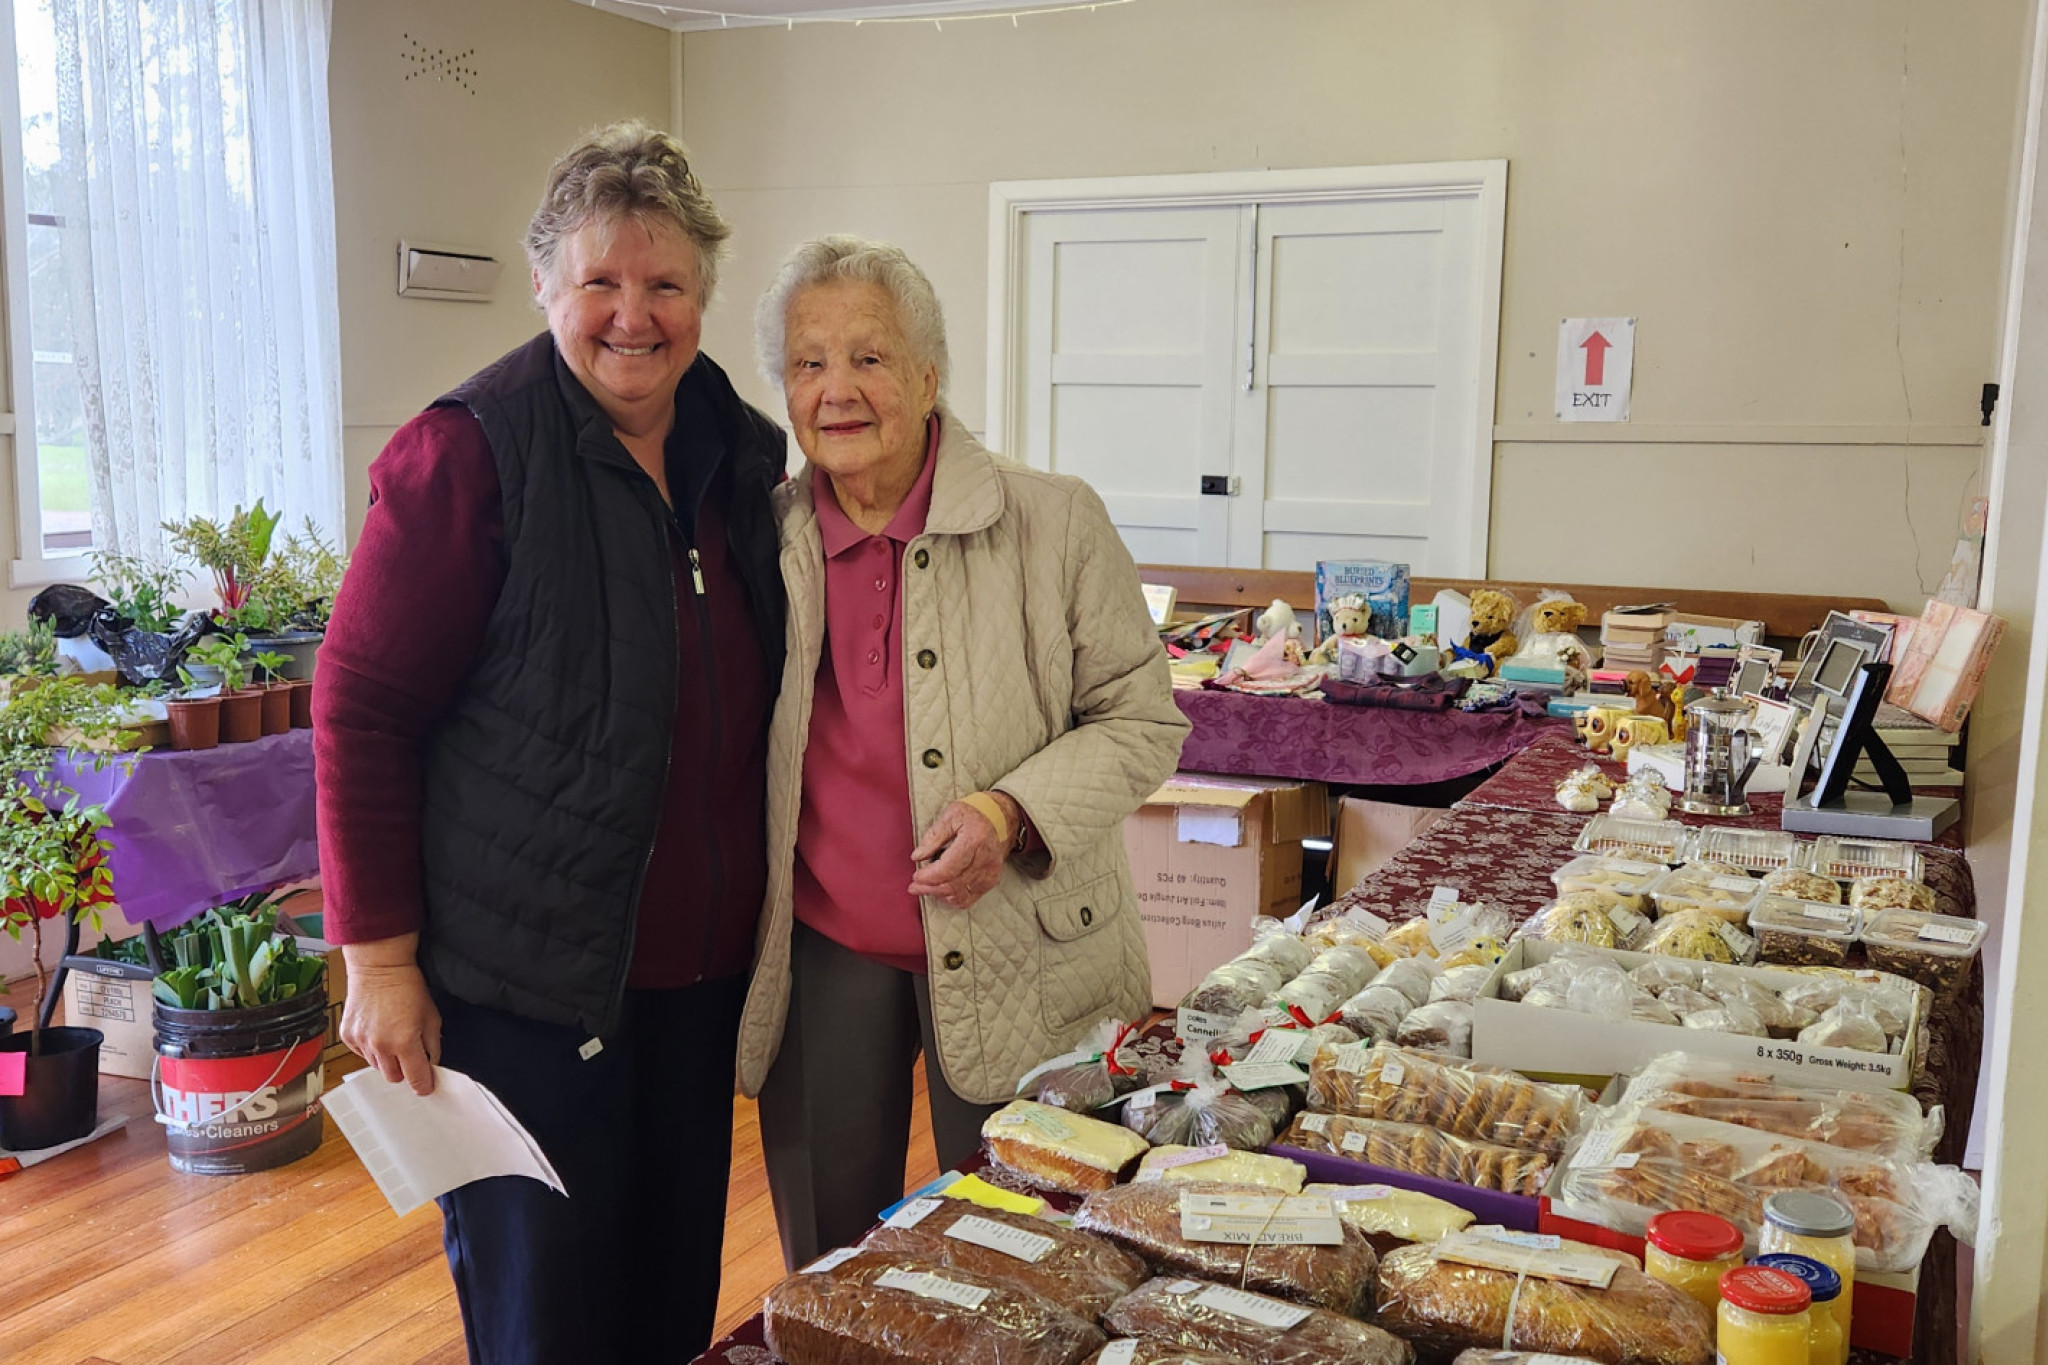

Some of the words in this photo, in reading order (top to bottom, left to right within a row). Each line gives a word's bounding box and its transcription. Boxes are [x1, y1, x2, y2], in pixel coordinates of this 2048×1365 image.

[1572, 392, 1612, 408] EXIT
[1344, 567, 1375, 575] BURIED
[1335, 575, 1383, 585] BLUEPRINTS
[1156, 872, 1174, 882] PCS
[1176, 895, 1189, 905] Art
[1190, 897, 1206, 907] Foil
[1757, 1046, 1764, 1057] 8
[1767, 1051, 1773, 1059] x
[1776, 1048, 1803, 1065] 350g
[1809, 1055, 1833, 1067] Gross
[1835, 1058, 1867, 1072] Weight:
[1868, 1062, 1891, 1076] 3.5kg
[1222, 1231, 1251, 1242] MIX
[1258, 1232, 1304, 1242] BREAD
